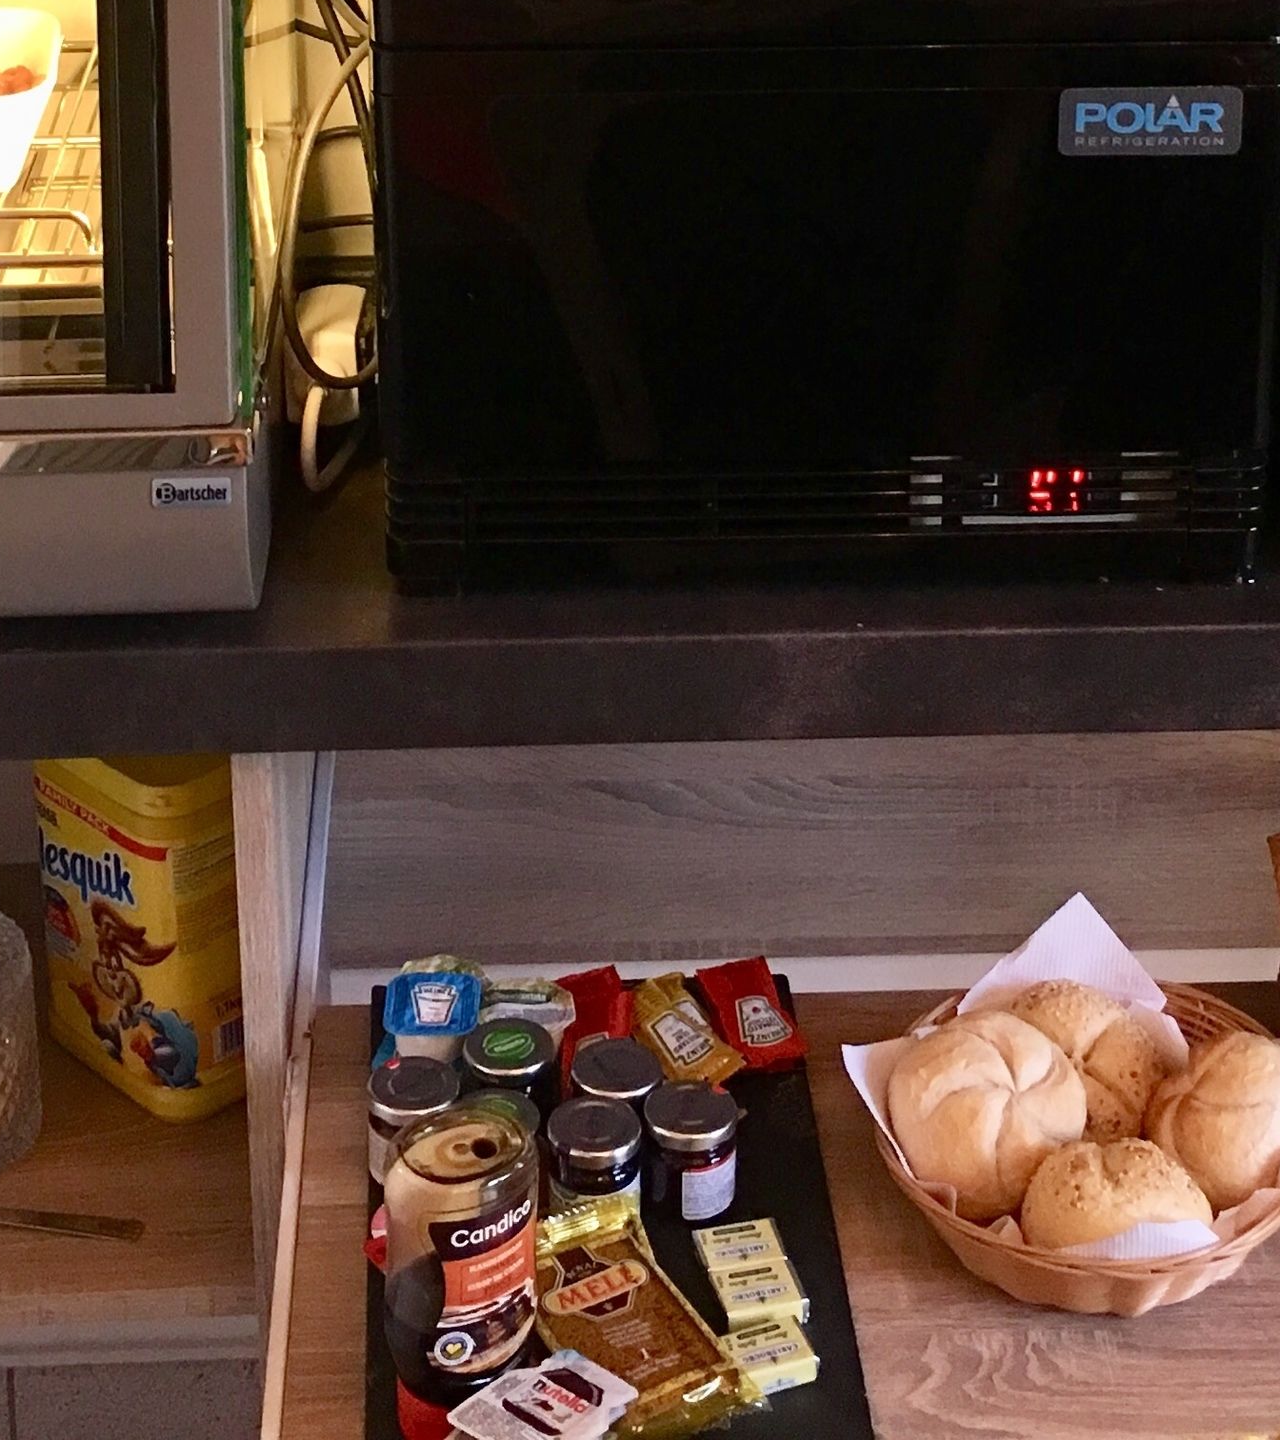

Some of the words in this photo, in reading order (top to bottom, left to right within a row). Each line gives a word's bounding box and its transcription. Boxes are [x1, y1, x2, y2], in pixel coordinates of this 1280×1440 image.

[1075, 95, 1225, 134] POLAR
[1074, 136, 1224, 147] REFRIGERATION
[156, 482, 228, 504] Bartscher
[450, 1199, 531, 1248] Candico
[533, 1379, 590, 1413] nutella
